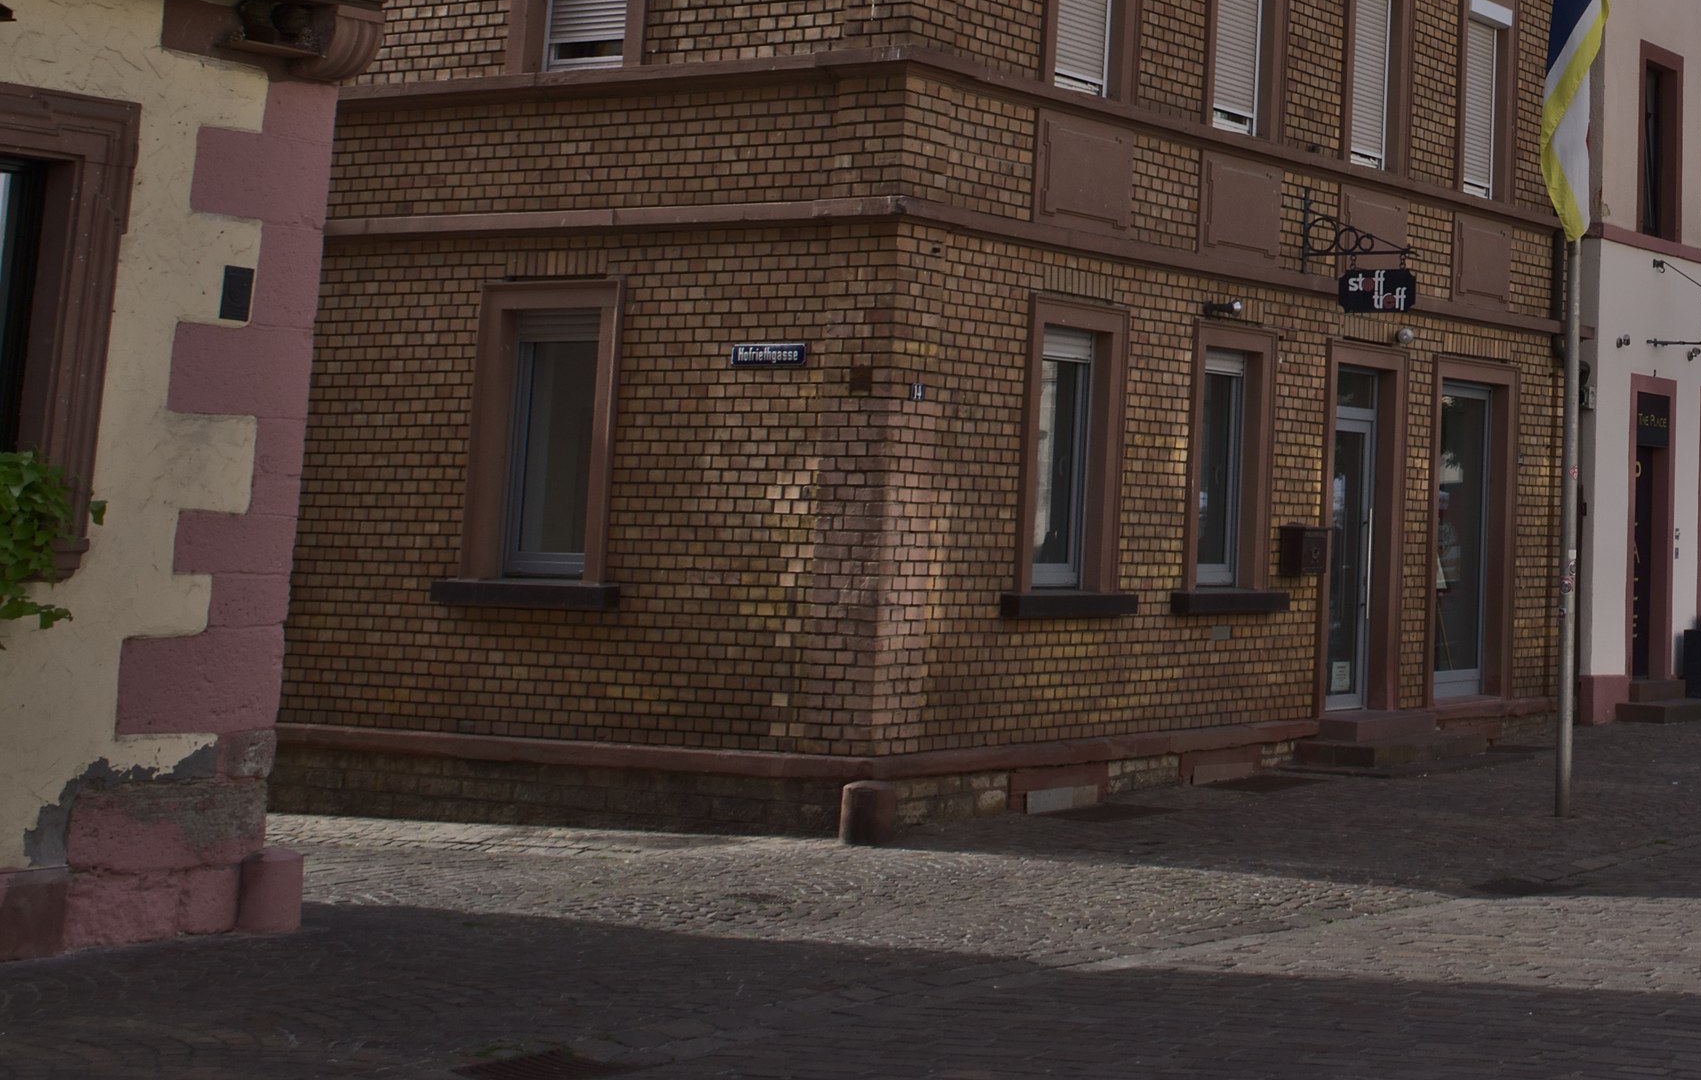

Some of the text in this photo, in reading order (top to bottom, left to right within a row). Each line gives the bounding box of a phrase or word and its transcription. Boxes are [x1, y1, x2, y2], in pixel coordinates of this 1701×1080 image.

[1348, 270, 1386, 292] stoff
[1373, 287, 1407, 311] treff
[737, 346, 799, 364] Hofriethgasse
